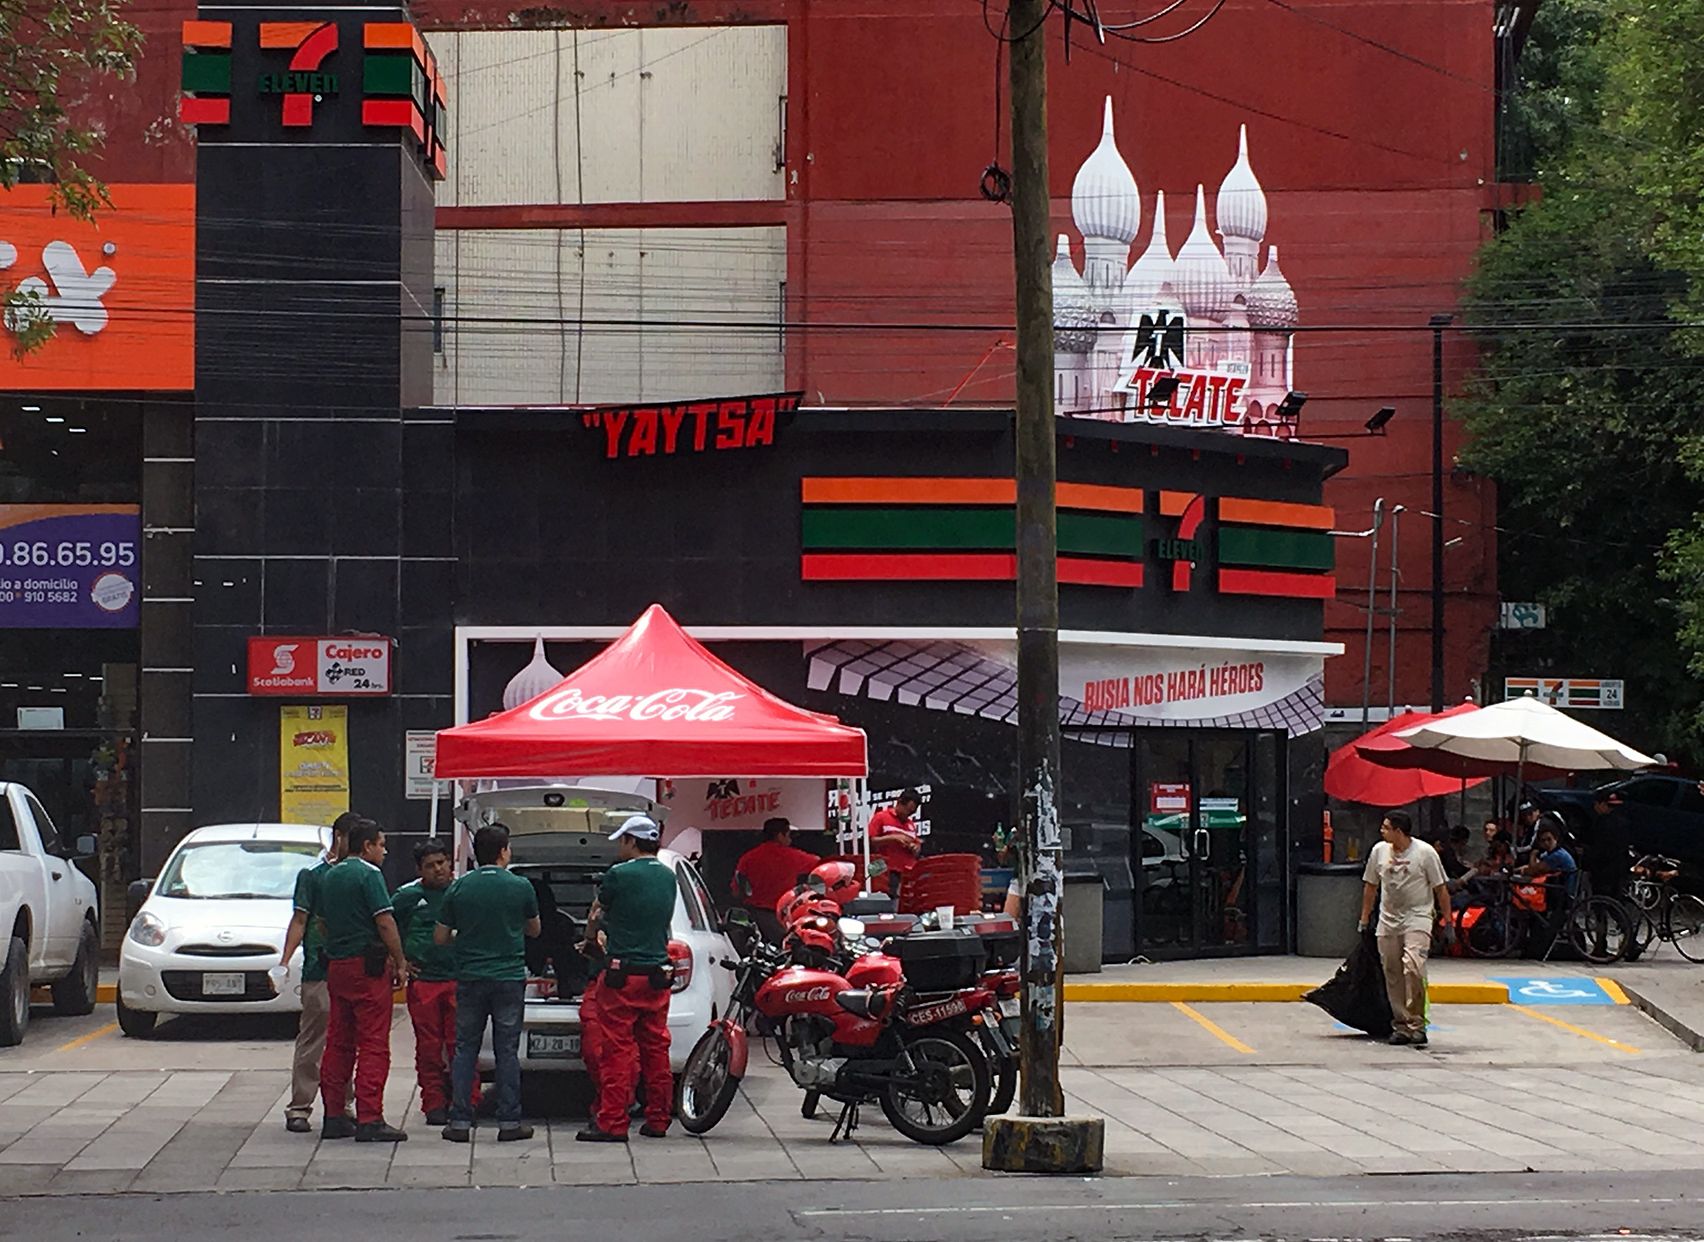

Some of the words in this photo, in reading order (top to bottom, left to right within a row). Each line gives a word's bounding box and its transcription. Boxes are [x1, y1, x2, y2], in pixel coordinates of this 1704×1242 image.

[260, 22, 339, 126] 7
[1160, 490, 1205, 591] 7
[0, 542, 134, 566] .86.65.95
[14, 581, 22, 590] a
[24, 578, 78, 590] domicilio
[25, 591, 45, 602] 910
[48, 591, 78, 602] 5682
[325, 644, 383, 662] Cajero
[343, 667, 366, 676] RED
[252, 676, 315, 687] Scotiabank
[353, 679, 370, 689] 24
[1084, 676, 1130, 714] RUSIA
[1133, 673, 1164, 707] NOS
[1167, 663, 1208, 703] HARÁ
[1210, 660, 1265, 698] HÉROES
[1606, 689, 1617, 700] 24
[529, 688, 748, 721] Coca-Cola
[704, 791, 783, 821] TECATE
